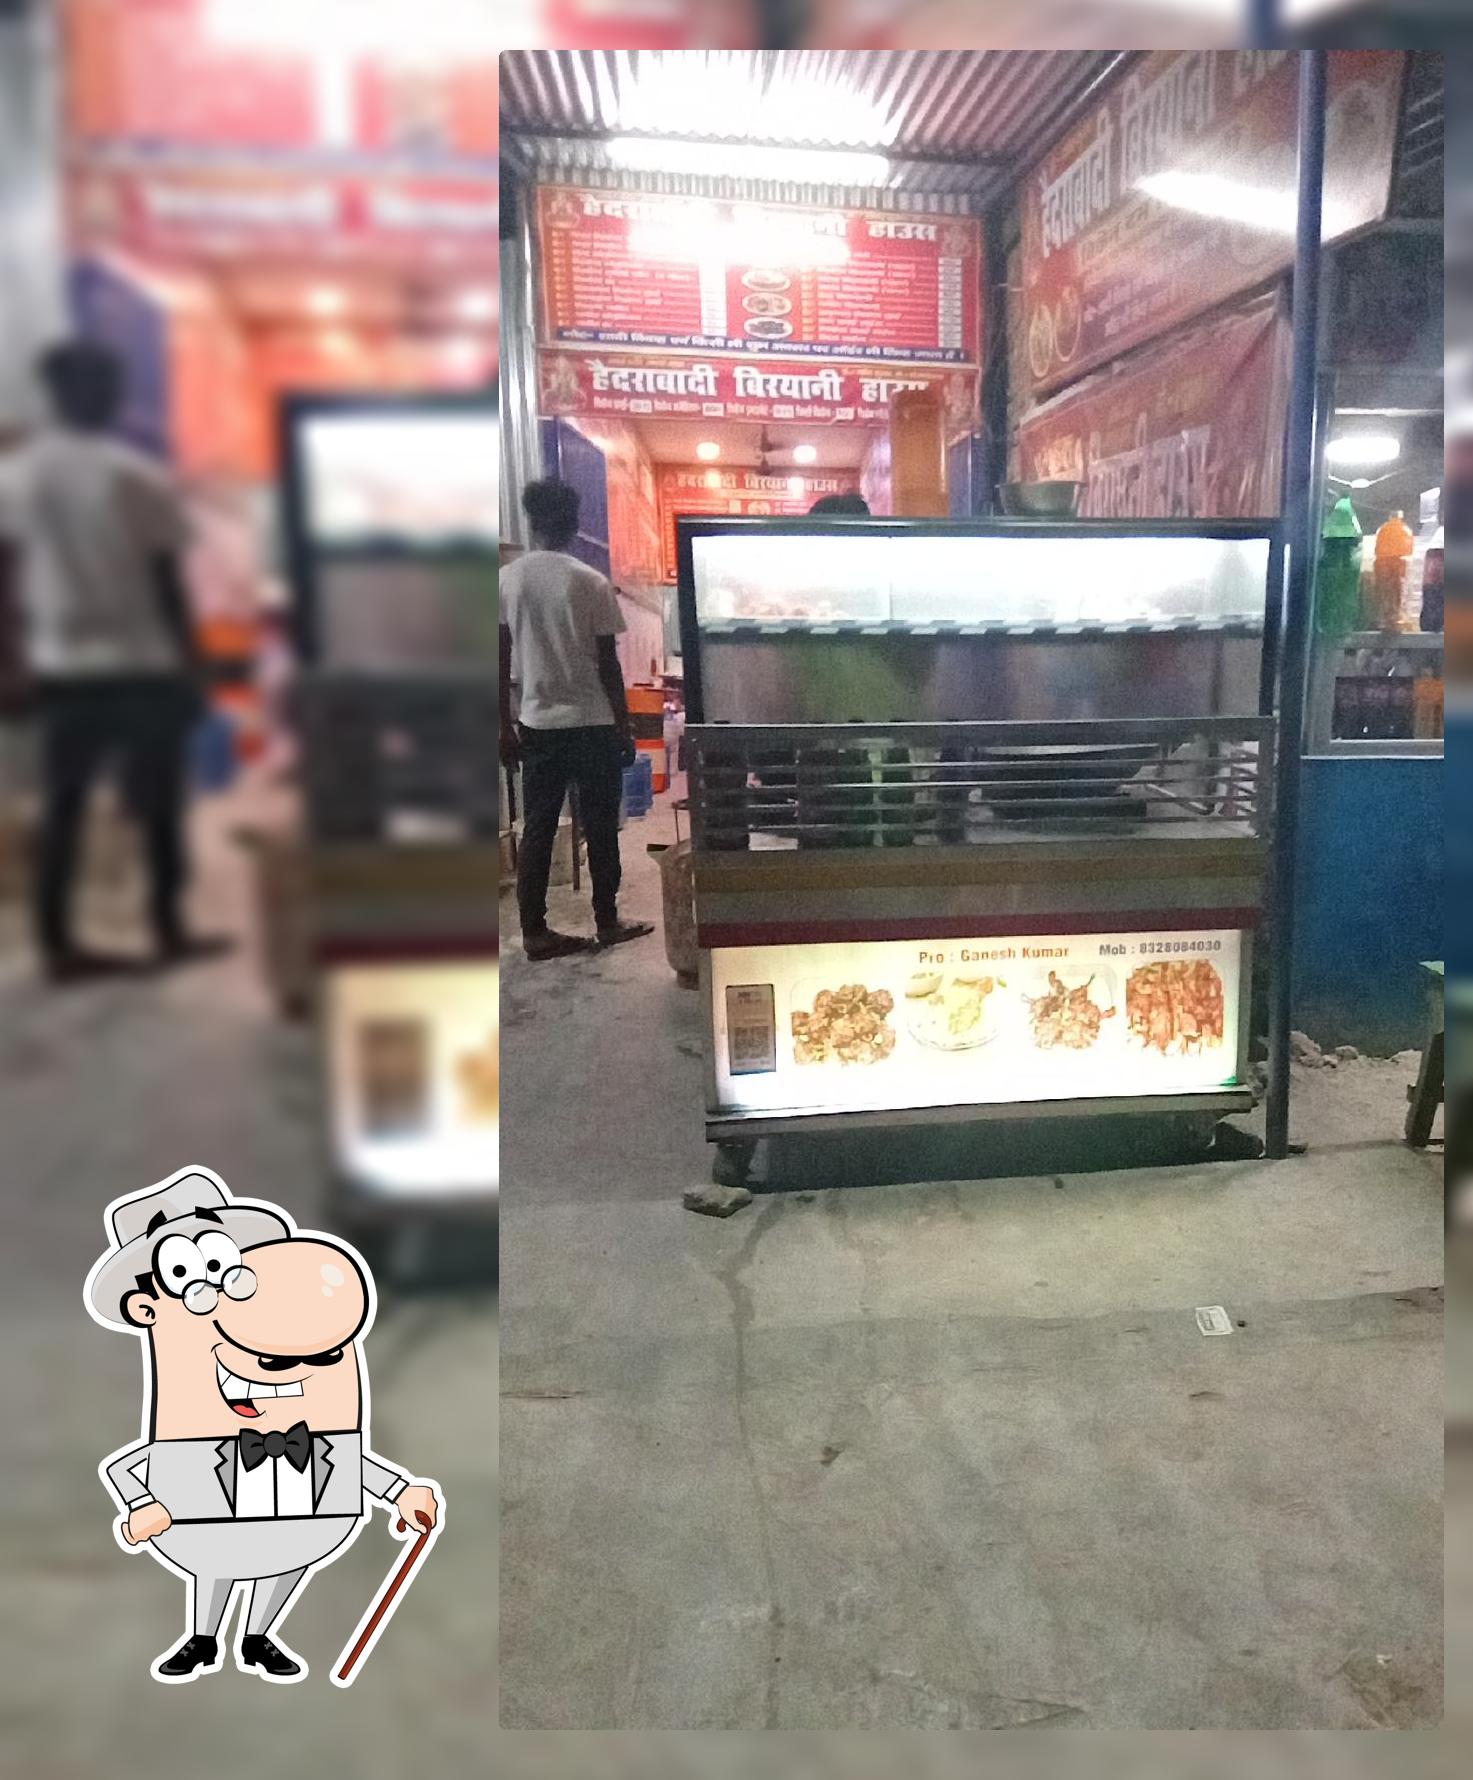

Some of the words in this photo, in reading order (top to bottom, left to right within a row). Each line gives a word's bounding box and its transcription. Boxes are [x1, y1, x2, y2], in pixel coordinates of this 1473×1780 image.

[960, 948, 1016, 962] Ganesh
[1022, 947, 1069, 959] Kumar
[1099, 944, 1126, 955] Mob
